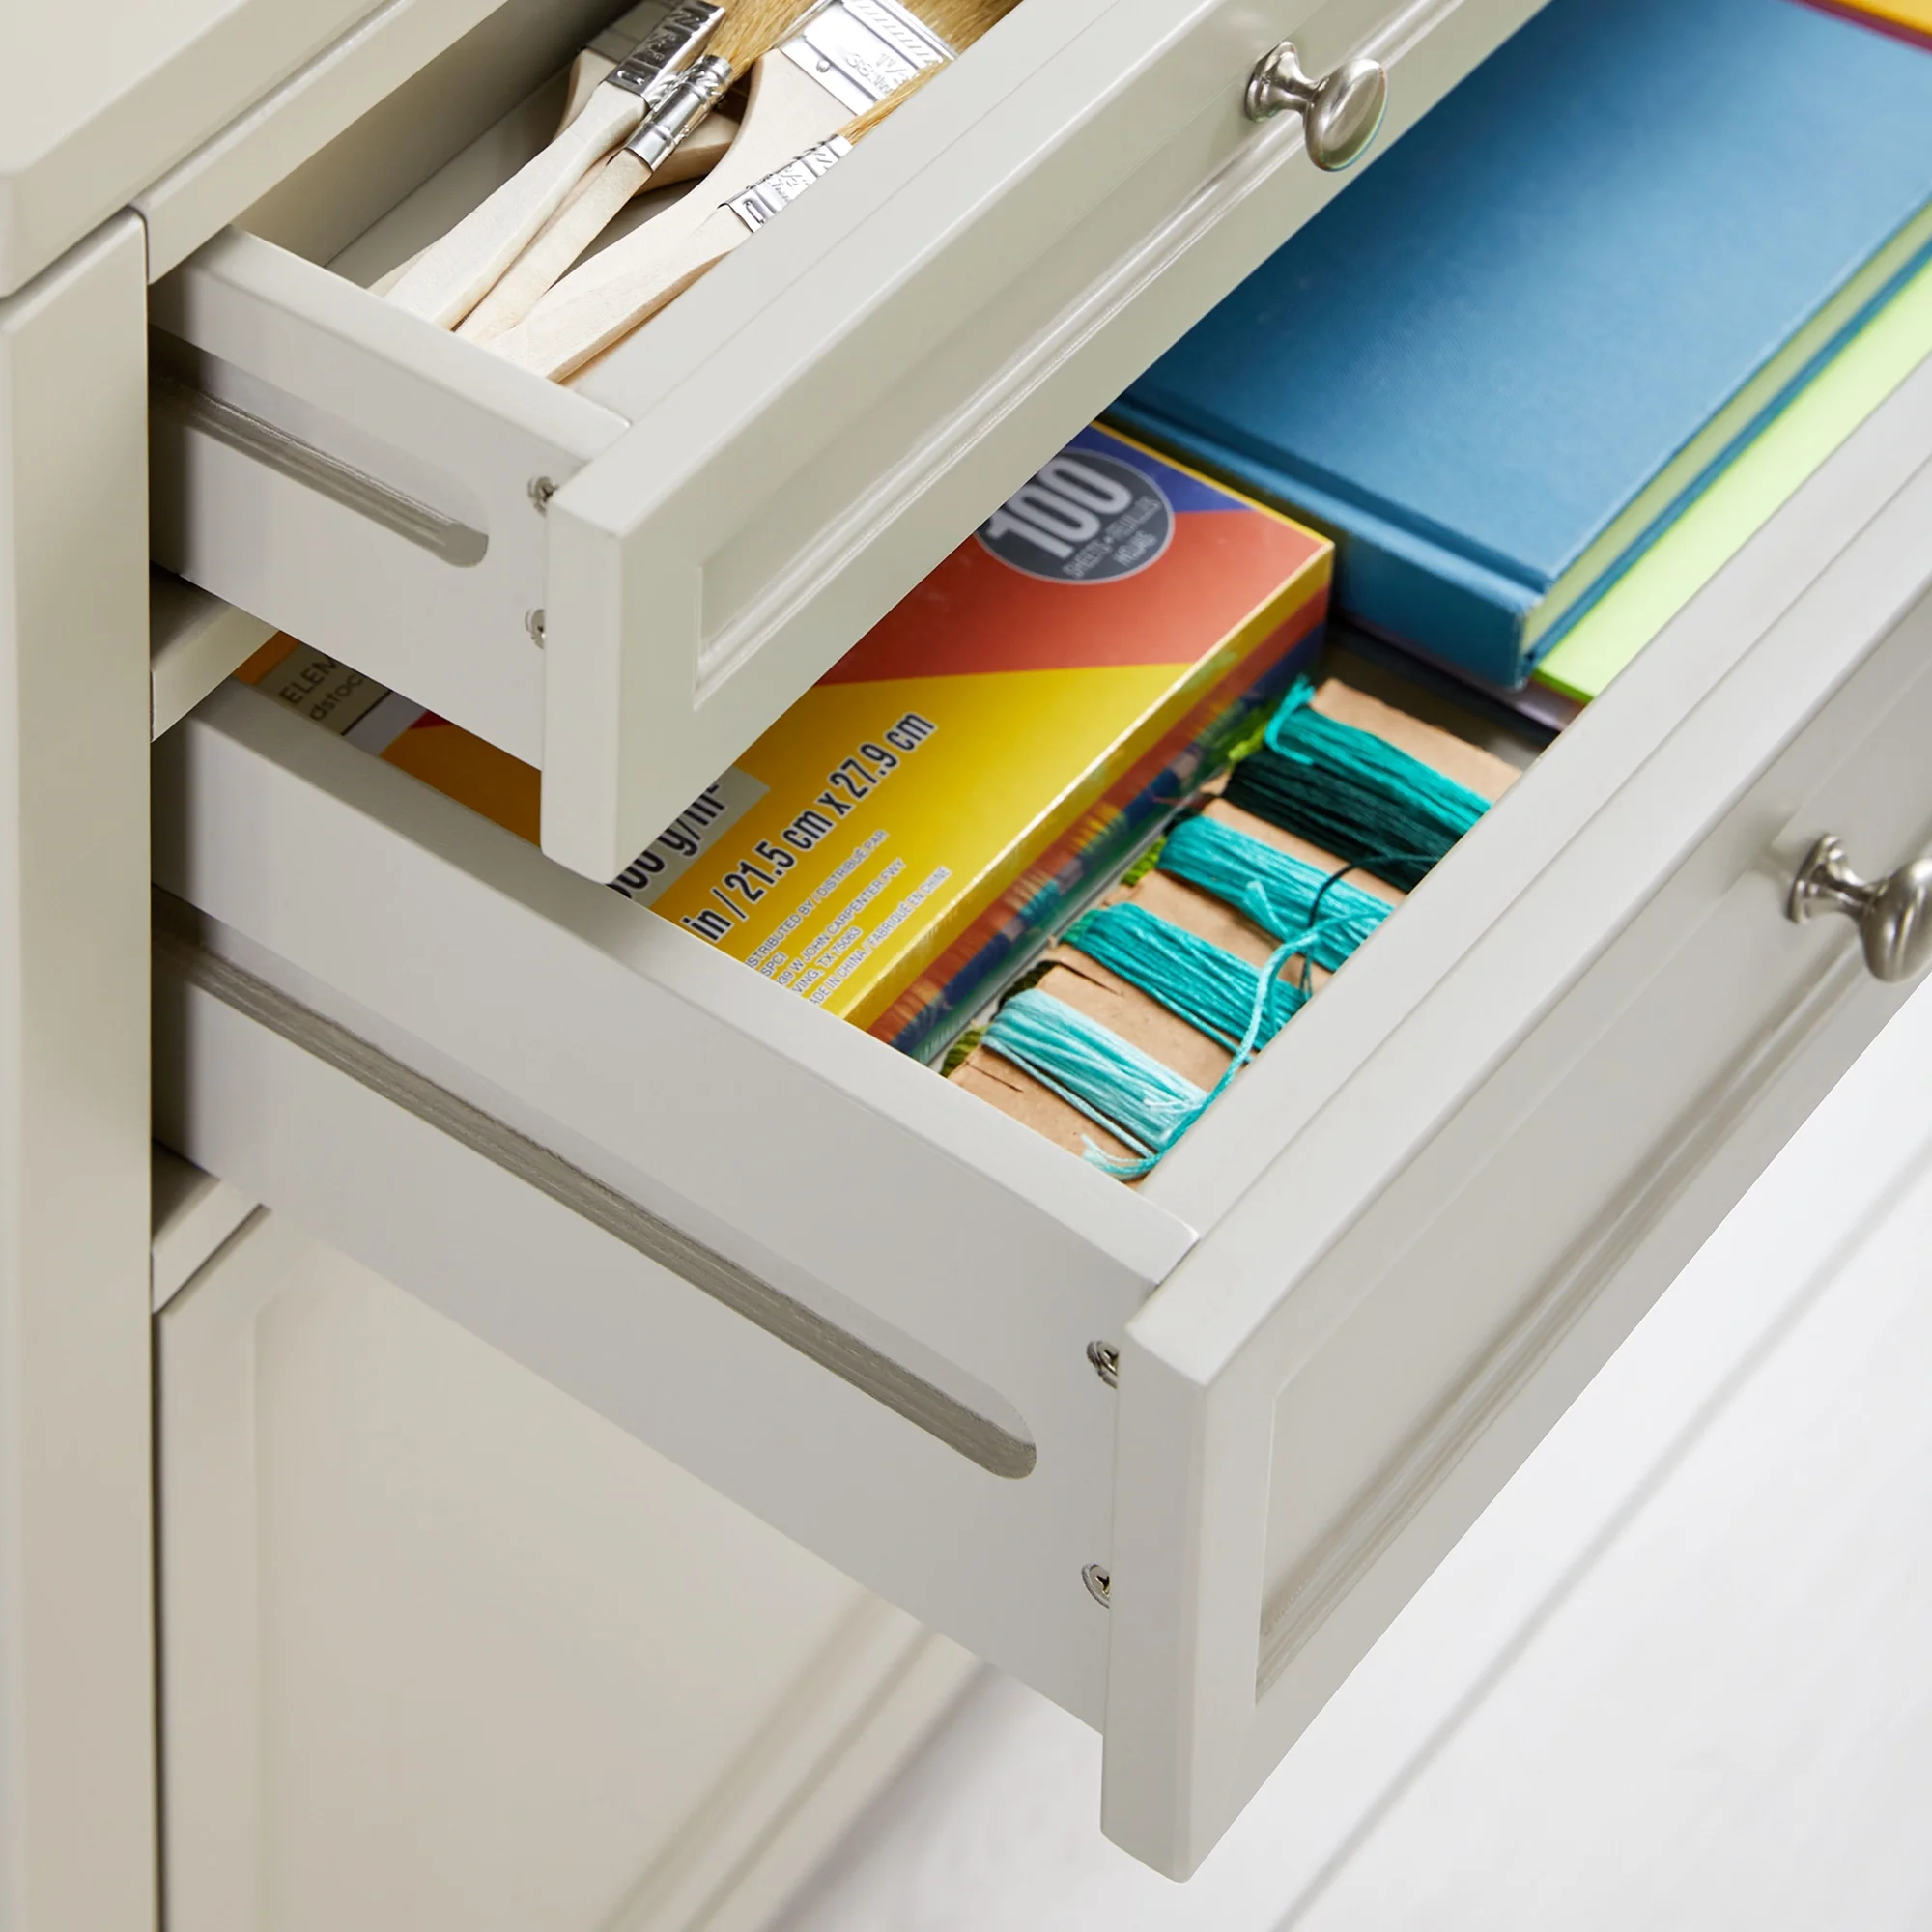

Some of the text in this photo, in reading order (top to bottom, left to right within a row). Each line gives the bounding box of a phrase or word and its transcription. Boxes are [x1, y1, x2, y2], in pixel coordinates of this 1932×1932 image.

[986, 457, 1132, 558] 100
[683, 713, 936, 941] in / 21.5 cm x 27.9 cm
[792, 959, 805, 972] W
[805, 933, 831, 961] JOHN
[827, 879, 884, 935] CARPENTER
[882, 859, 904, 881] FWY
[800, 899, 815, 916] BY
[819, 849, 867, 896] DISTRIBUÉ
[826, 976, 840, 989] IN
[838, 952, 865, 978] CHINA
[868, 901, 913, 945] FABRIQUÉ
[909, 891, 925, 906] EN
[921, 867, 950, 892] CHINE
[761, 953, 786, 977] SPCI
[818, 951, 835, 968] TX
[833, 927, 861, 953] 75063
